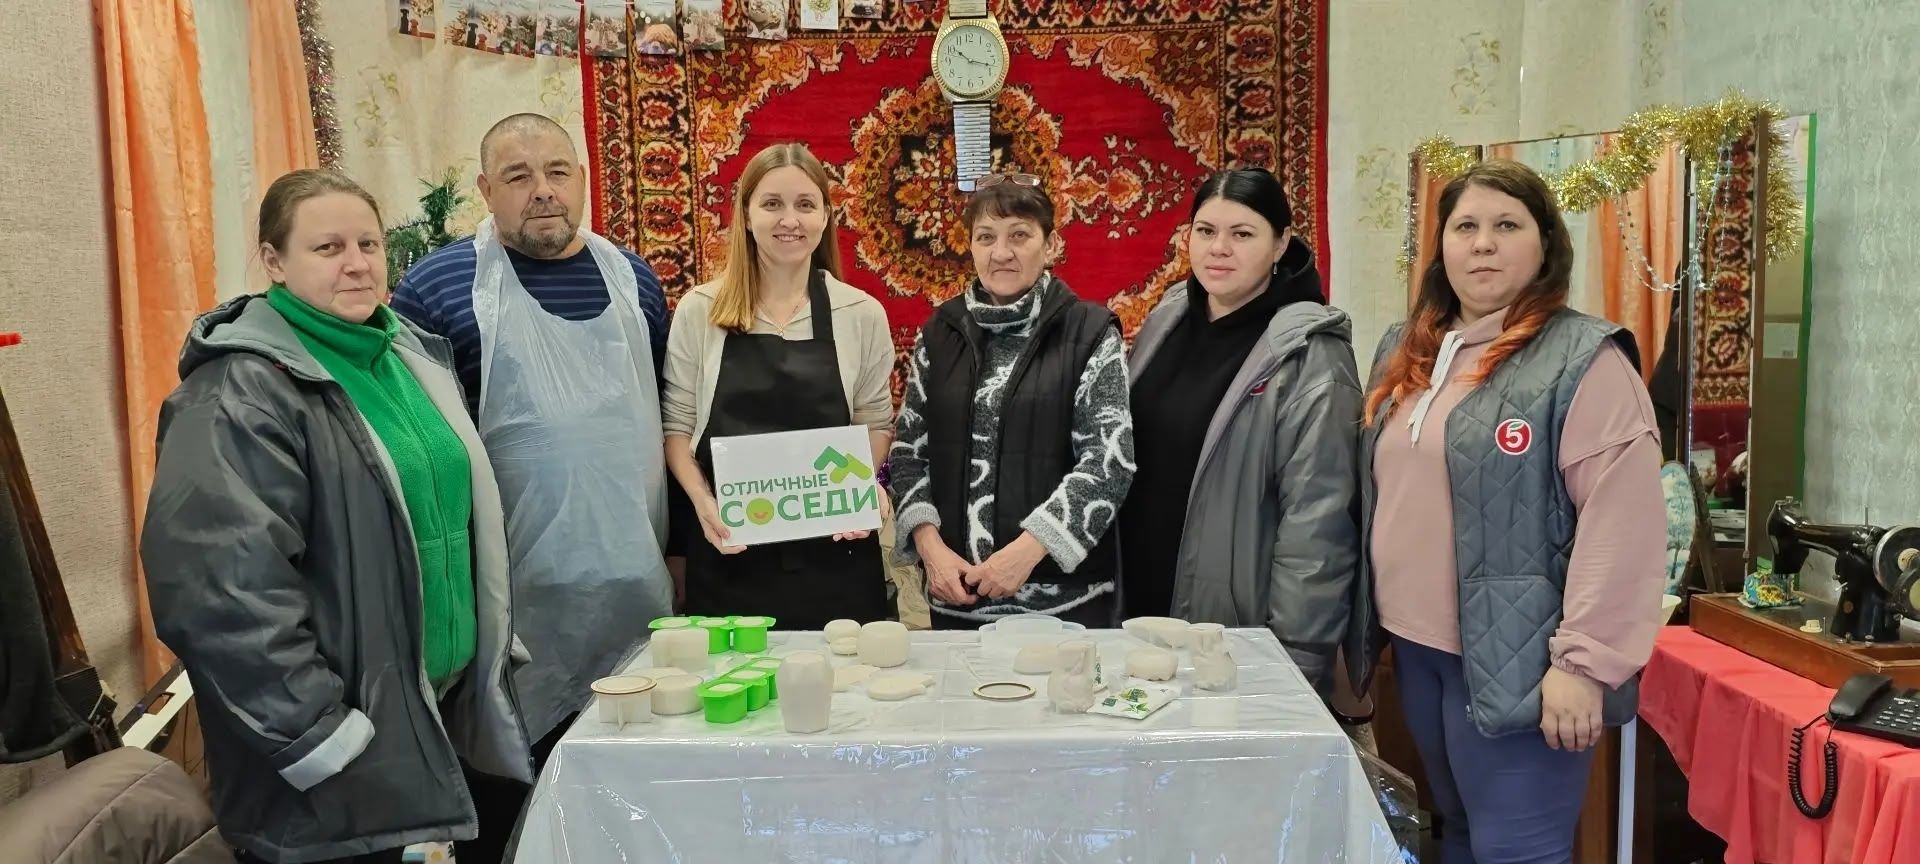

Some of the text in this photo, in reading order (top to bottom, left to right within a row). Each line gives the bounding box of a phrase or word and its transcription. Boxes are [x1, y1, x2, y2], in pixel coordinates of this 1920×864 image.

[956, 36, 962, 46] 11
[965, 33, 974, 43] 12
[947, 45, 956, 54] 10
[986, 43, 992, 52] 2
[945, 56, 951, 65] 9
[949, 68, 955, 78] 8
[967, 79, 974, 88] 6
[1505, 421, 1525, 449] 5
[720, 473, 829, 497] ОТЛИЧНЫЕ
[720, 484, 879, 528] СОСЕДИ
